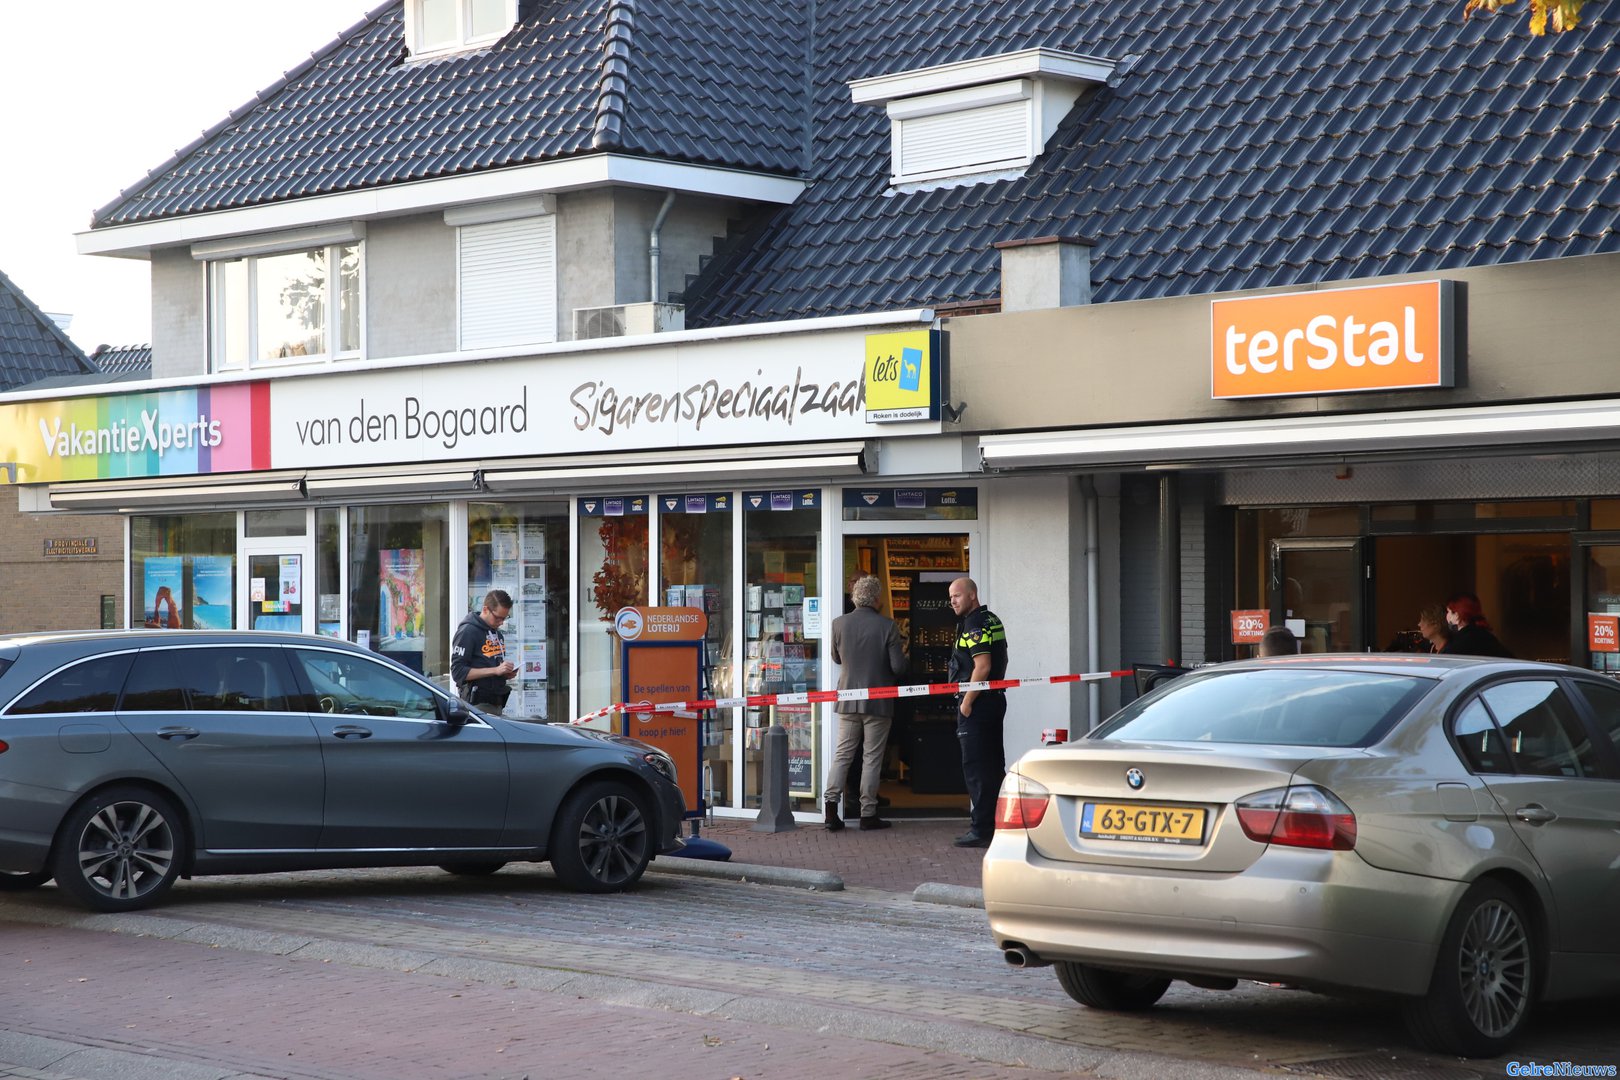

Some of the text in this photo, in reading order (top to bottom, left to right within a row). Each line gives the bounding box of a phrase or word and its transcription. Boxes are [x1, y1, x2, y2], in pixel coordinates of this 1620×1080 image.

[1226, 306, 1424, 375] terStal
[873, 354, 899, 383] let's
[296, 385, 527, 449] van den Bogaard
[39, 409, 222, 457] VakantieXperts
[647, 614, 699, 623] NEDERLANDSE
[1239, 619, 1263, 630] 20%
[647, 624, 680, 633] LOTERIJ
[1594, 625, 1614, 637] 20%
[1594, 637, 1614, 645] KORTING
[633, 683, 690, 695] De spellen van
[639, 727, 687, 738] koop je hier!
[1083, 820, 1091, 828] NL
[1101, 808, 1194, 834] 63-GTX-7
